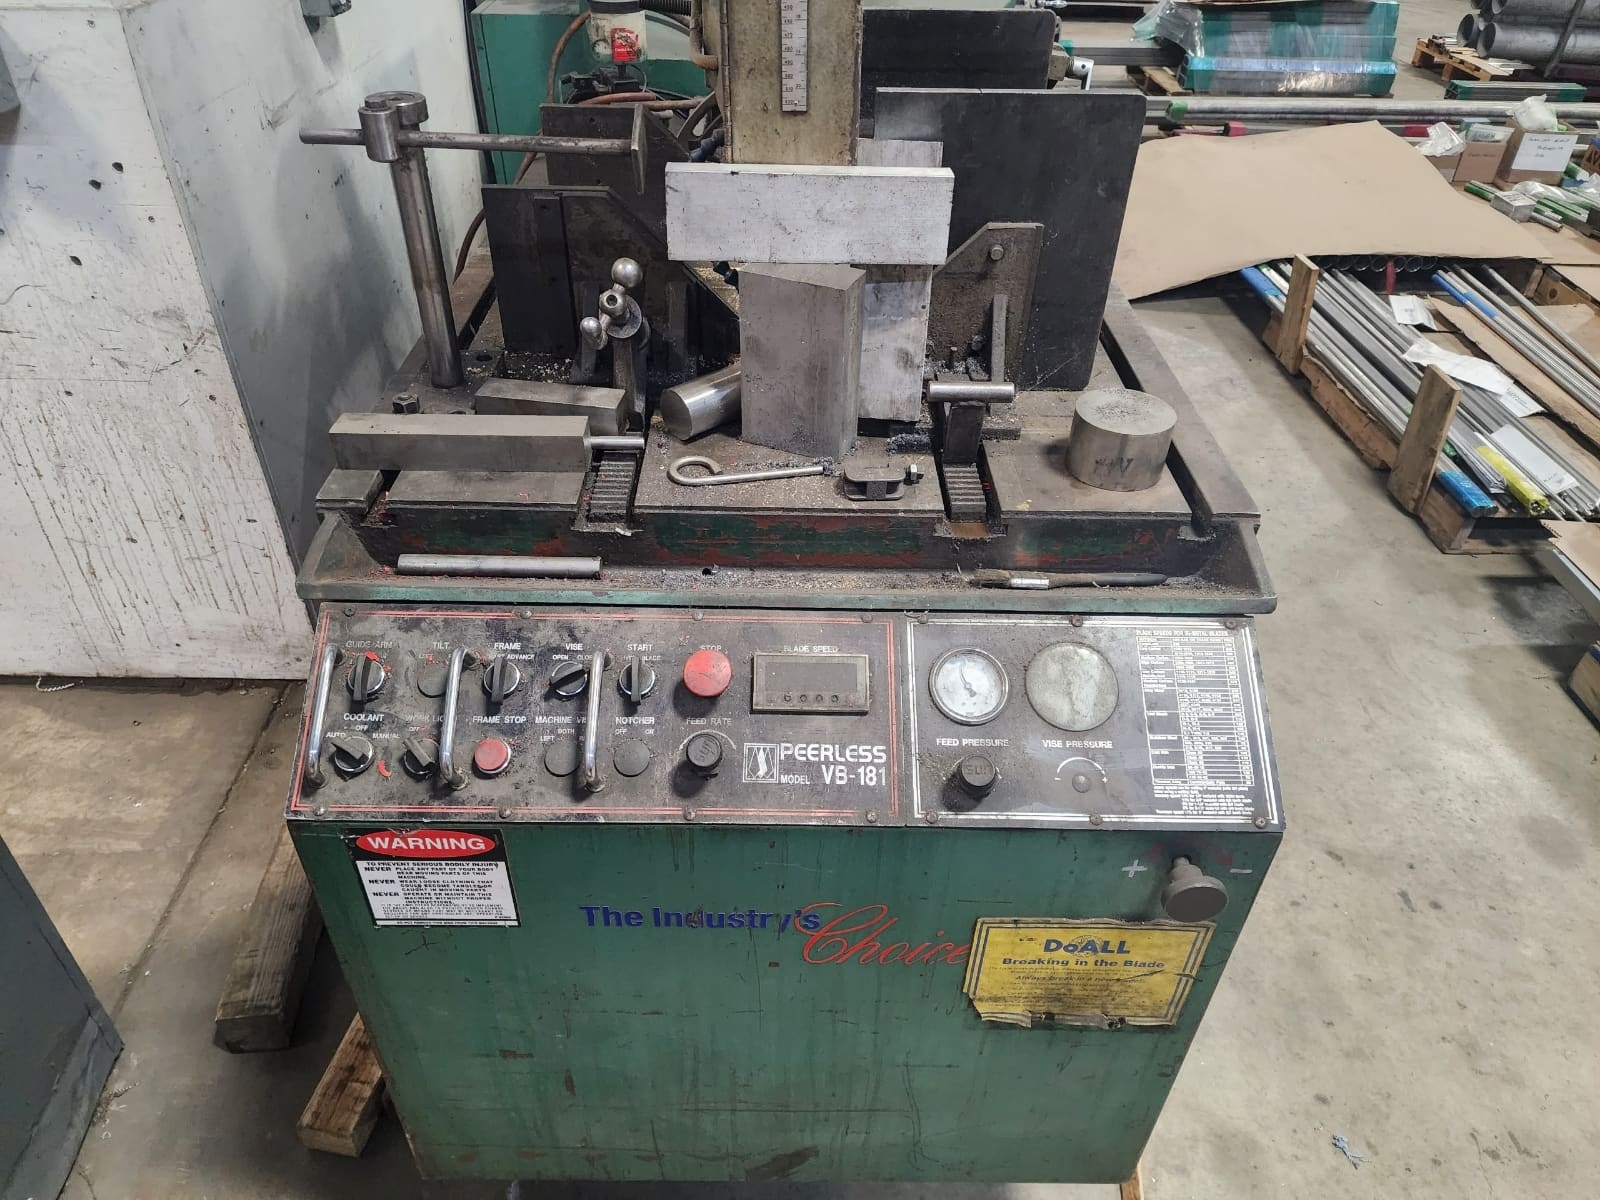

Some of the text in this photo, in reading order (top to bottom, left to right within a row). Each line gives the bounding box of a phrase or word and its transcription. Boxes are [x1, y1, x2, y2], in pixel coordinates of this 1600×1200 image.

[374, 641, 392, 649] ARM
[432, 642, 450, 650] TILT
[494, 642, 521, 650] FRAME
[344, 712, 384, 722] COOLANT
[472, 716, 527, 724] FRAME STOP
[615, 717, 656, 725] NOTCHER
[936, 738, 1010, 747] FEED PRESSURE
[1042, 740, 1113, 748] VISE PRESSURE
[780, 742, 887, 763] PEERLESS
[780, 764, 886, 786] MODEL VB-181
[366, 837, 486, 850] WARNING
[580, 905, 821, 932] The Industry's
[795, 902, 969, 966] Choice
[1044, 939, 1131, 955] DoALL
[1002, 958, 1070, 966] Breaking
[1074, 958, 1089, 966] in
[1123, 960, 1166, 968] Blade
